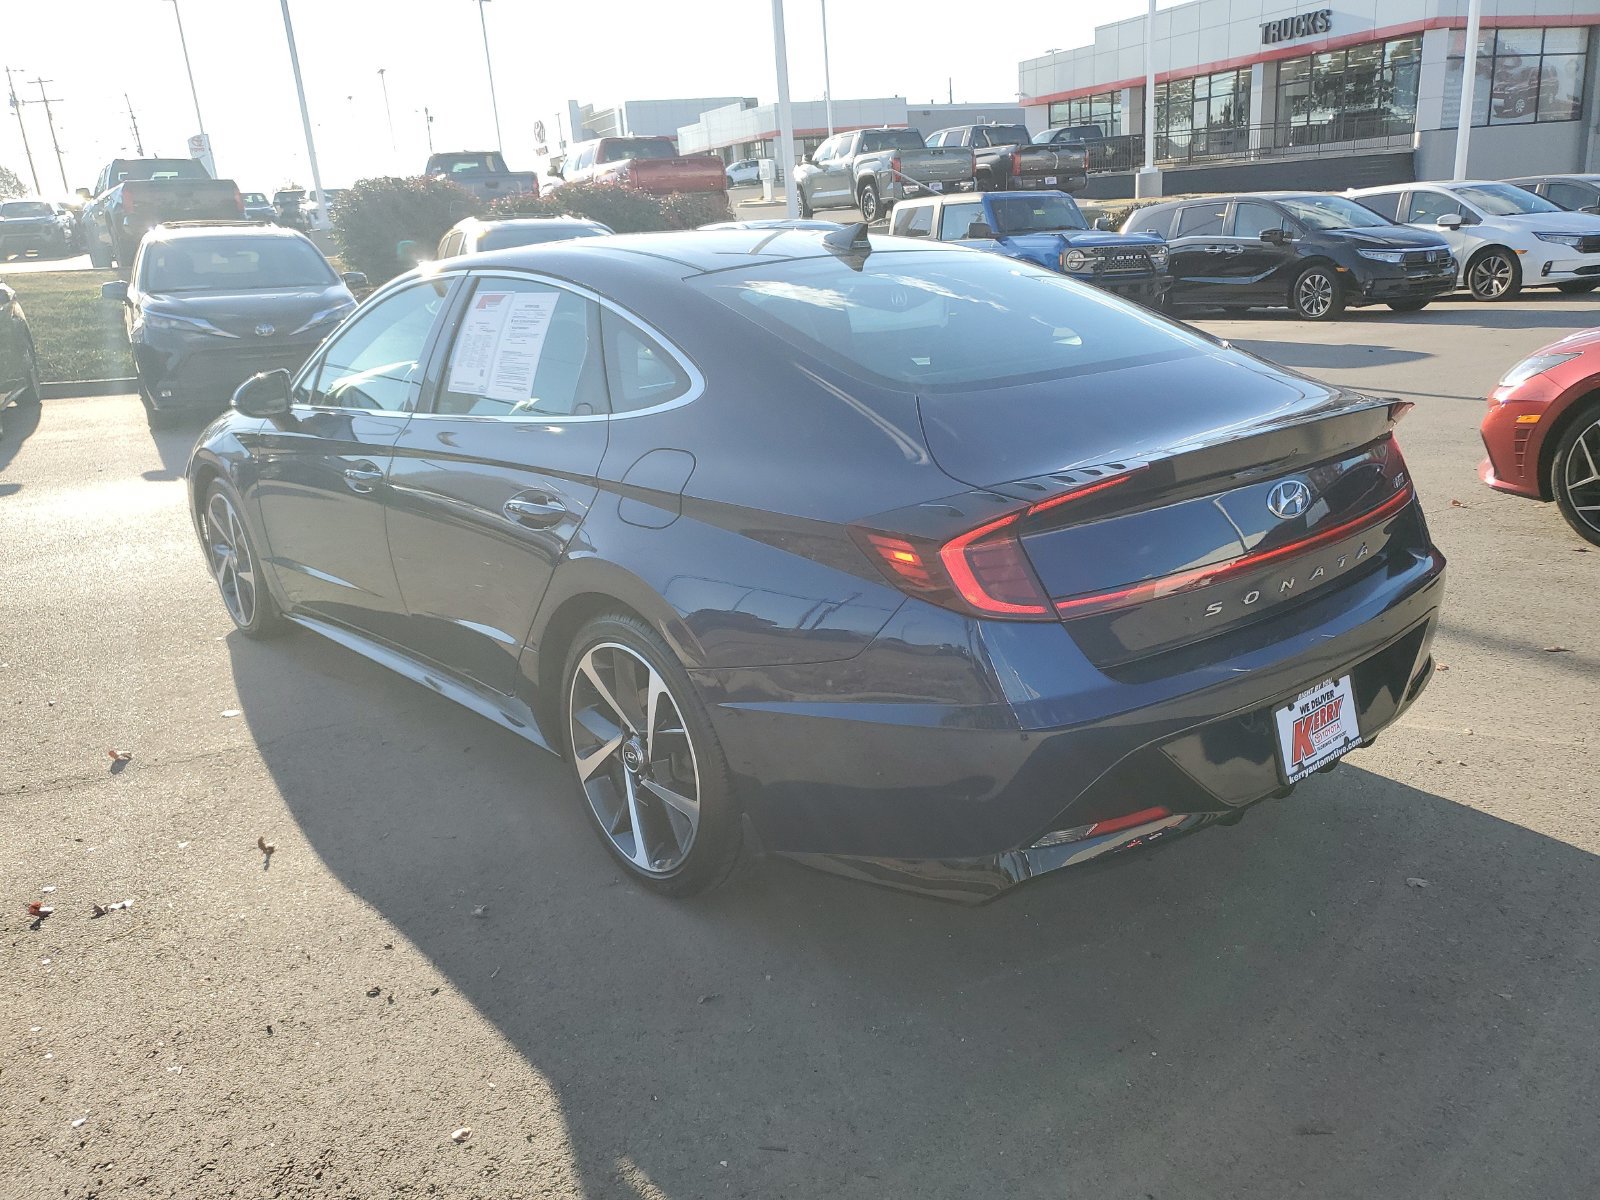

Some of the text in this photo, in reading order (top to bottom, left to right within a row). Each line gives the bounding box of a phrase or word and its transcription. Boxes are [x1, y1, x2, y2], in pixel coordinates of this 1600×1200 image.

[1259, 9, 1332, 44] TRUCKS
[1204, 542, 1369, 617] SONATA
[1300, 690, 1335, 715] WE DELIVER
[1292, 695, 1344, 767] KERRY
[1321, 723, 1341, 738] TOYOTA
[1289, 737, 1363, 785] kerryautomotive.com
